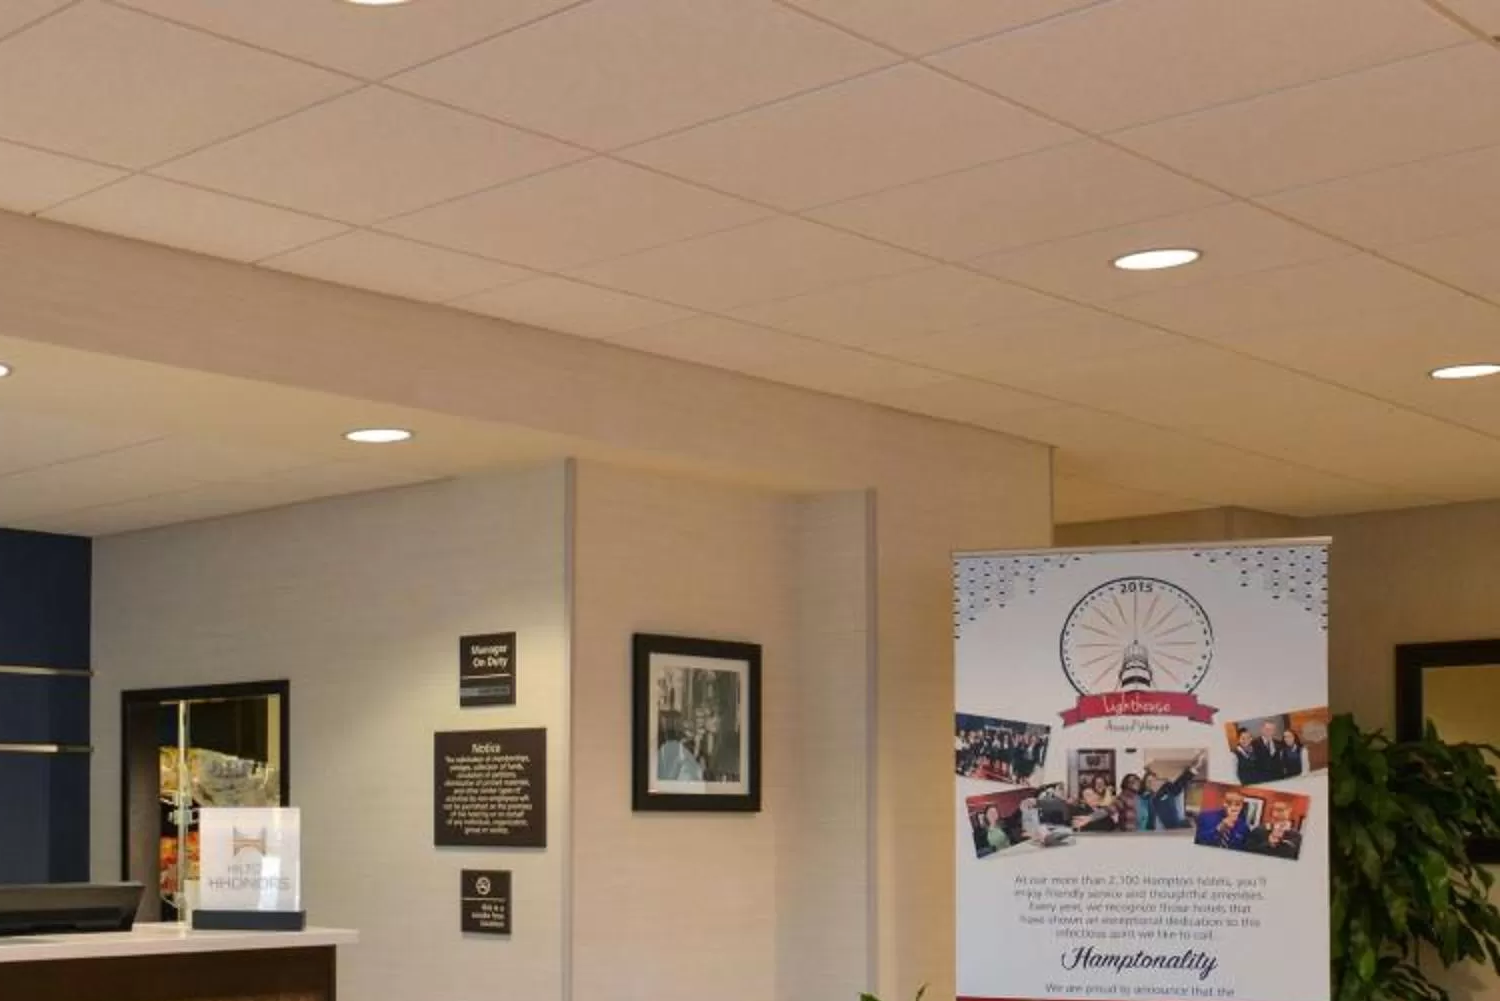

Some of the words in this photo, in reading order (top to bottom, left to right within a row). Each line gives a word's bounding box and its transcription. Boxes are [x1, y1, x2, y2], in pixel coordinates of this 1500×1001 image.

[1120, 581, 1153, 594] 2015
[470, 644, 508, 656] Manager
[472, 657, 486, 668] On
[487, 656, 509, 669] Duty
[1103, 692, 1171, 716] Lighthouse
[471, 743, 501, 753] Notice
[1061, 946, 1218, 981] Hamptonality
[1045, 983, 1062, 993] We
[1085, 985, 1116, 995] proud
[1191, 985, 1213, 996] that
[1217, 987, 1235, 996] the
